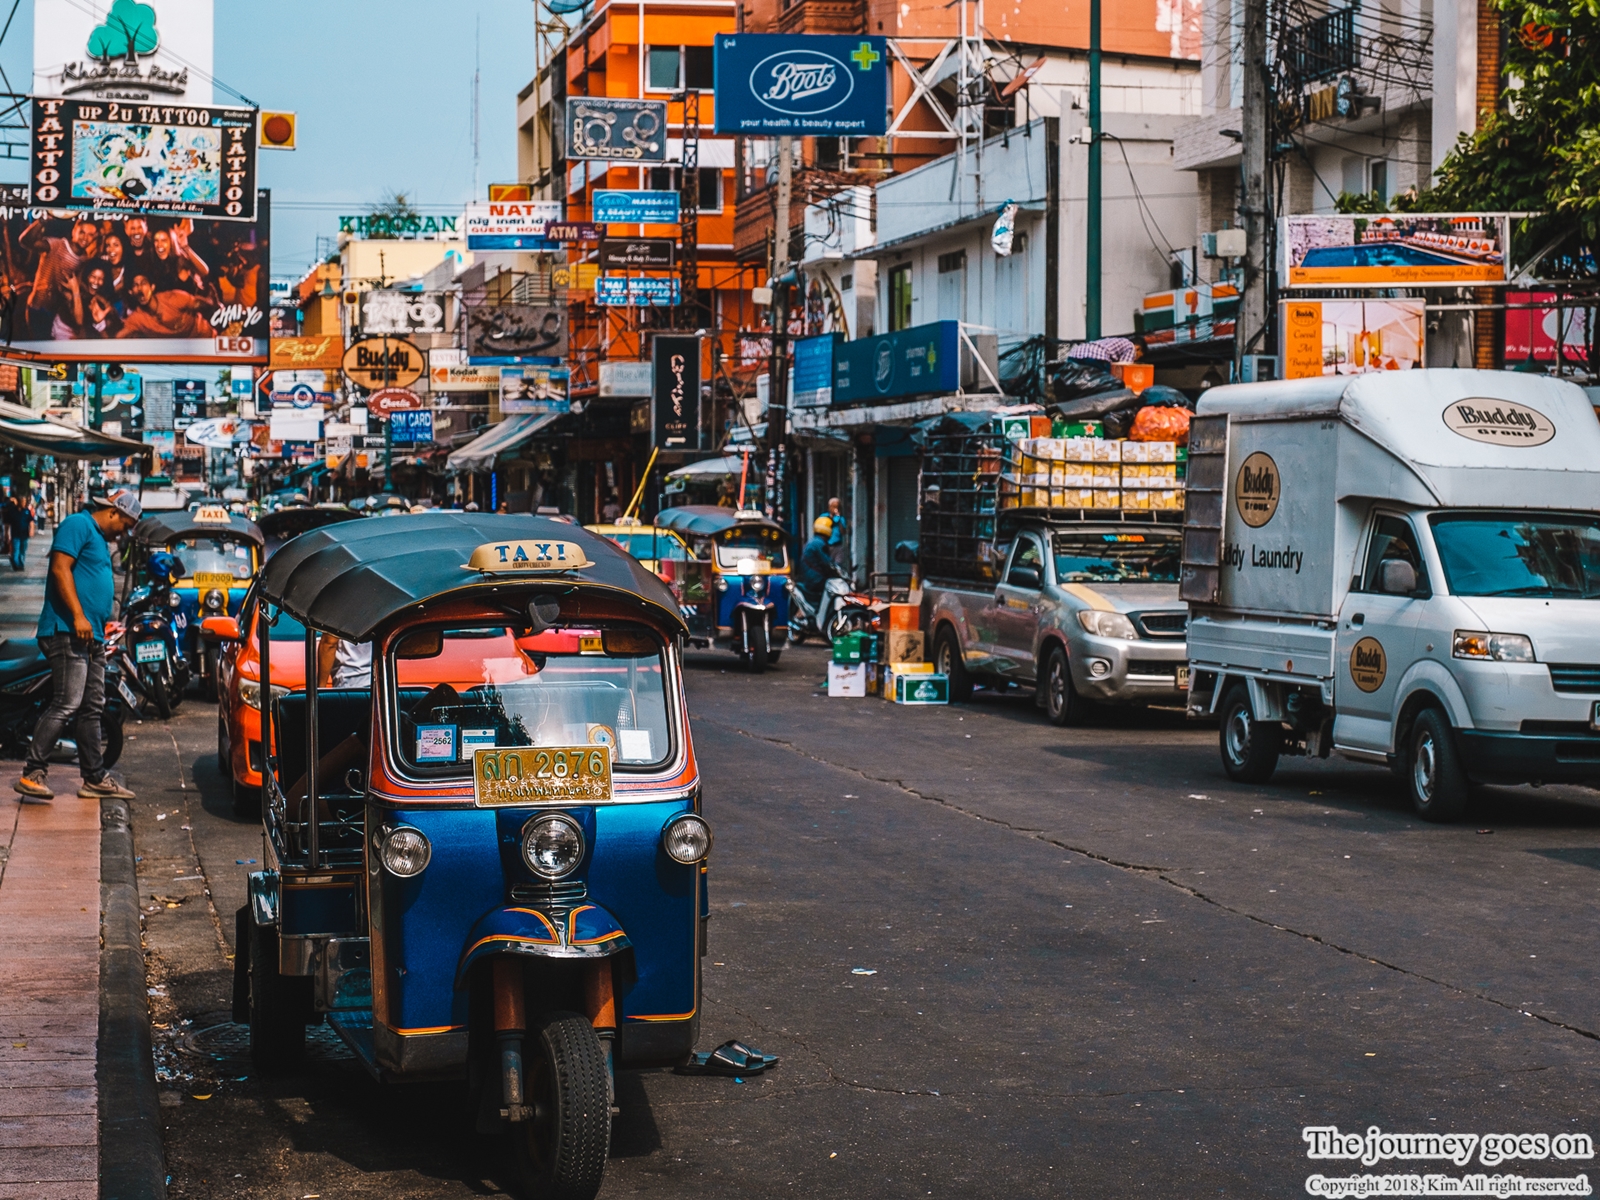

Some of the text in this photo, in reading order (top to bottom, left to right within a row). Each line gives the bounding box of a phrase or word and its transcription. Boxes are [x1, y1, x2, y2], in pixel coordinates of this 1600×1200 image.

[762, 62, 836, 101] Boots
[78, 105, 103, 120] UP
[137, 106, 211, 126] TATTOO
[740, 118, 866, 129] your health & beauty expert
[35, 100, 65, 201] TATTOO
[223, 127, 248, 216] TATTOO
[489, 204, 536, 217] NAT
[338, 215, 458, 234] KHAOSAN
[548, 225, 578, 240] ATM
[210, 304, 263, 329] CHAI-YO
[217, 338, 251, 353] LEO
[356, 346, 409, 372] Buddy
[449, 368, 479, 376] Kodak
[391, 411, 432, 428] SIM CARD
[1456, 405, 1538, 431] Buddy
[1242, 465, 1275, 500] Buddy
[202, 509, 223, 519] TAXI
[494, 544, 567, 562] TAXI
[1251, 543, 1304, 574] Laundry
[1355, 645, 1382, 674] Buddy
[433, 735, 453, 746] 2562
[534, 750, 606, 779] 2876
